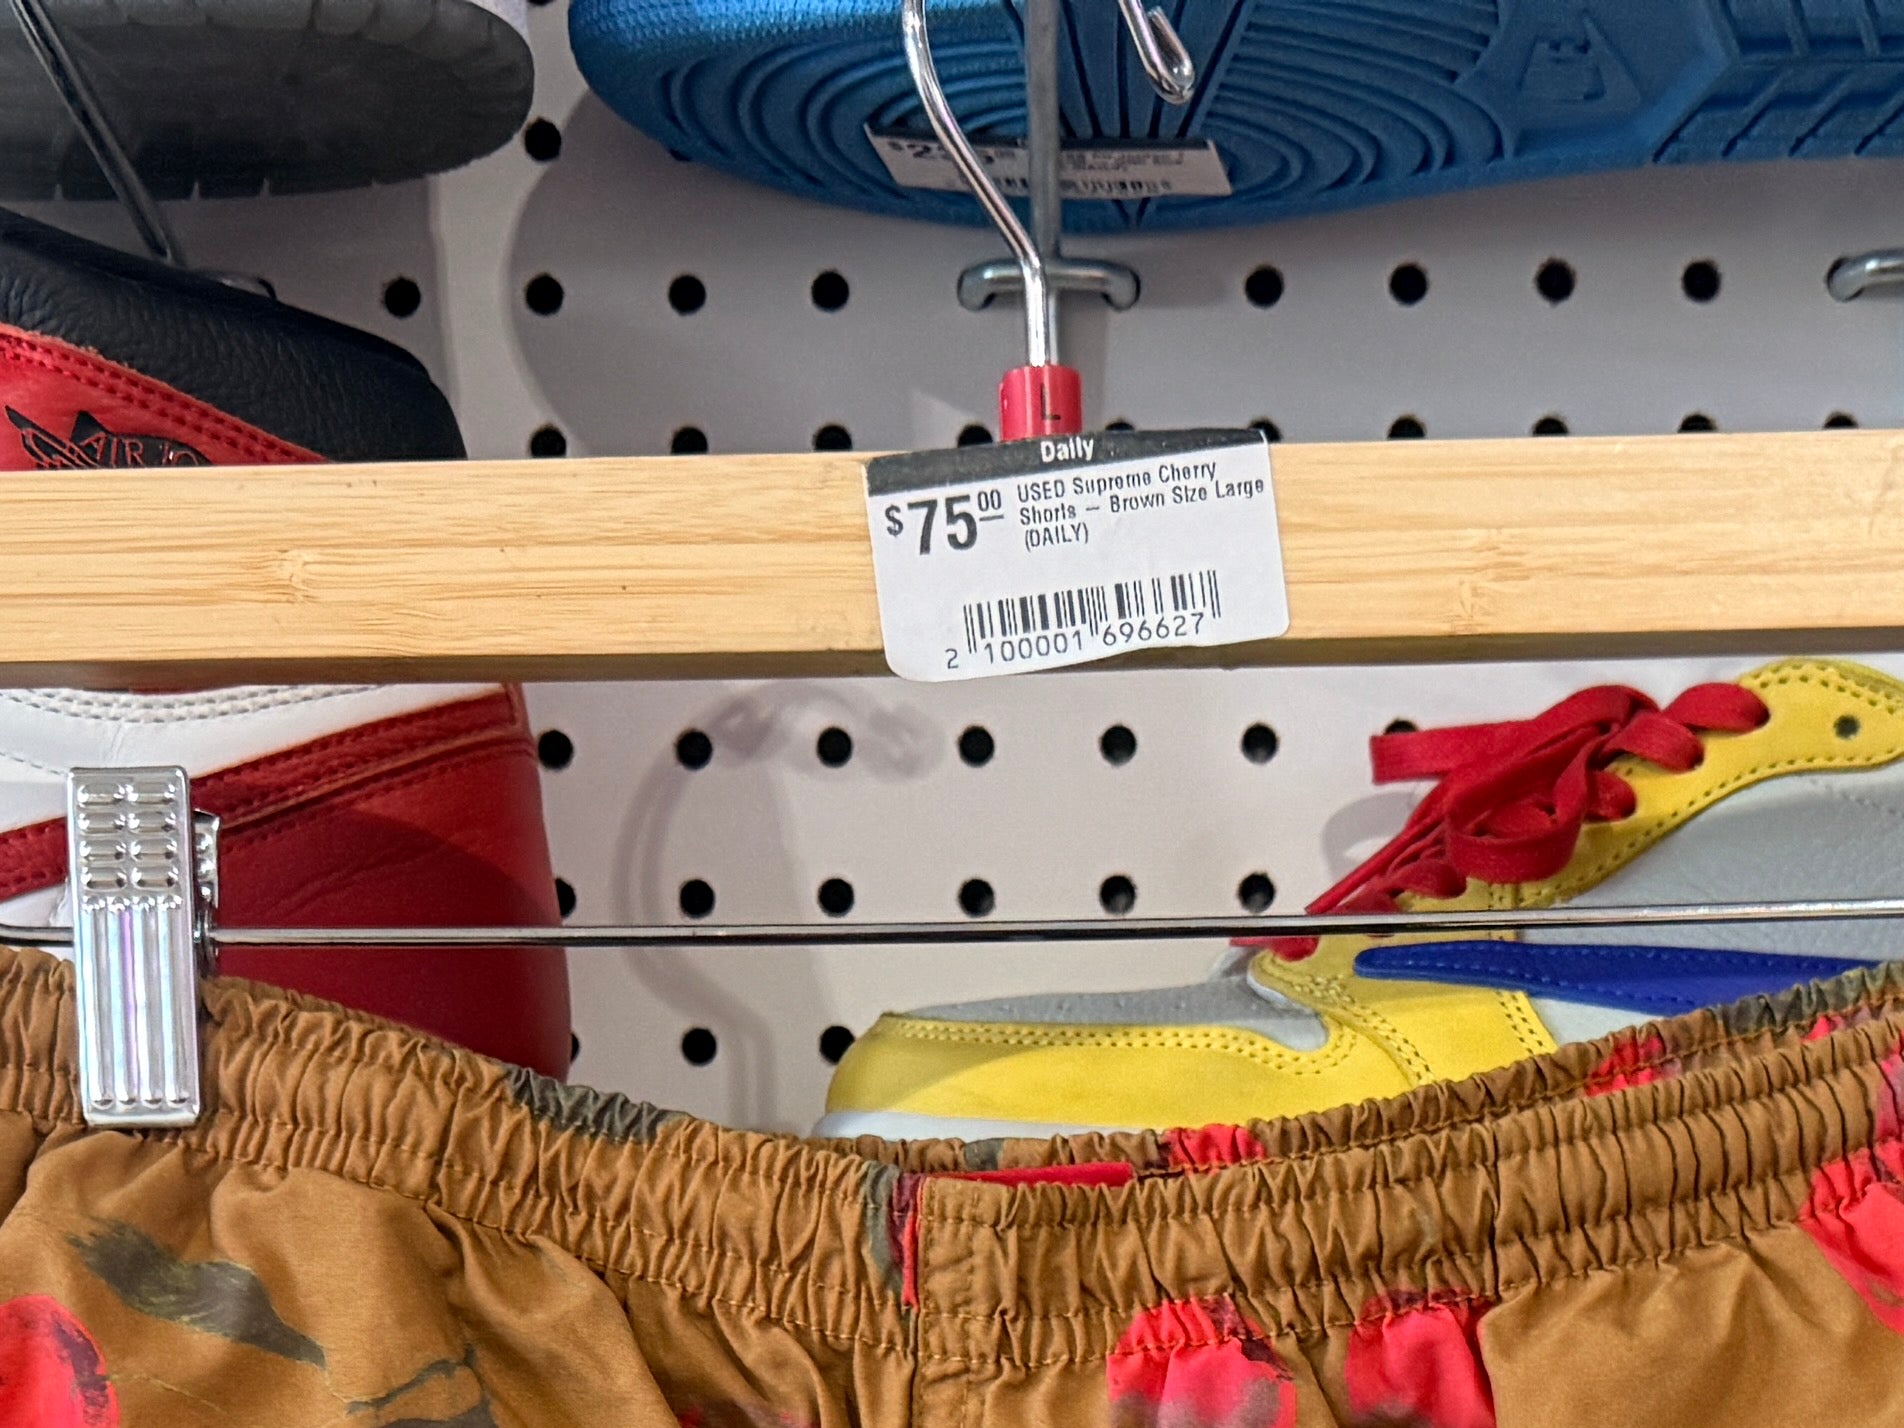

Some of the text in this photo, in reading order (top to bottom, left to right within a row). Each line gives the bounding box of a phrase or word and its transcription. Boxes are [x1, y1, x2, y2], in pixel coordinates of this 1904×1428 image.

[1040, 383, 1061, 420] L
[1040, 436, 1094, 462] Daily
[1017, 462, 1216, 503] USED Supreme Cherry
[1020, 504, 1077, 526] Shorts
[1110, 492, 1165, 514] Brown
[1172, 486, 1207, 504] Size
[1215, 478, 1265, 500] Large
[1025, 522, 1090, 551] (DAILY)
[984, 630, 1084, 664] 100001
[1103, 612, 1204, 646] 696627
